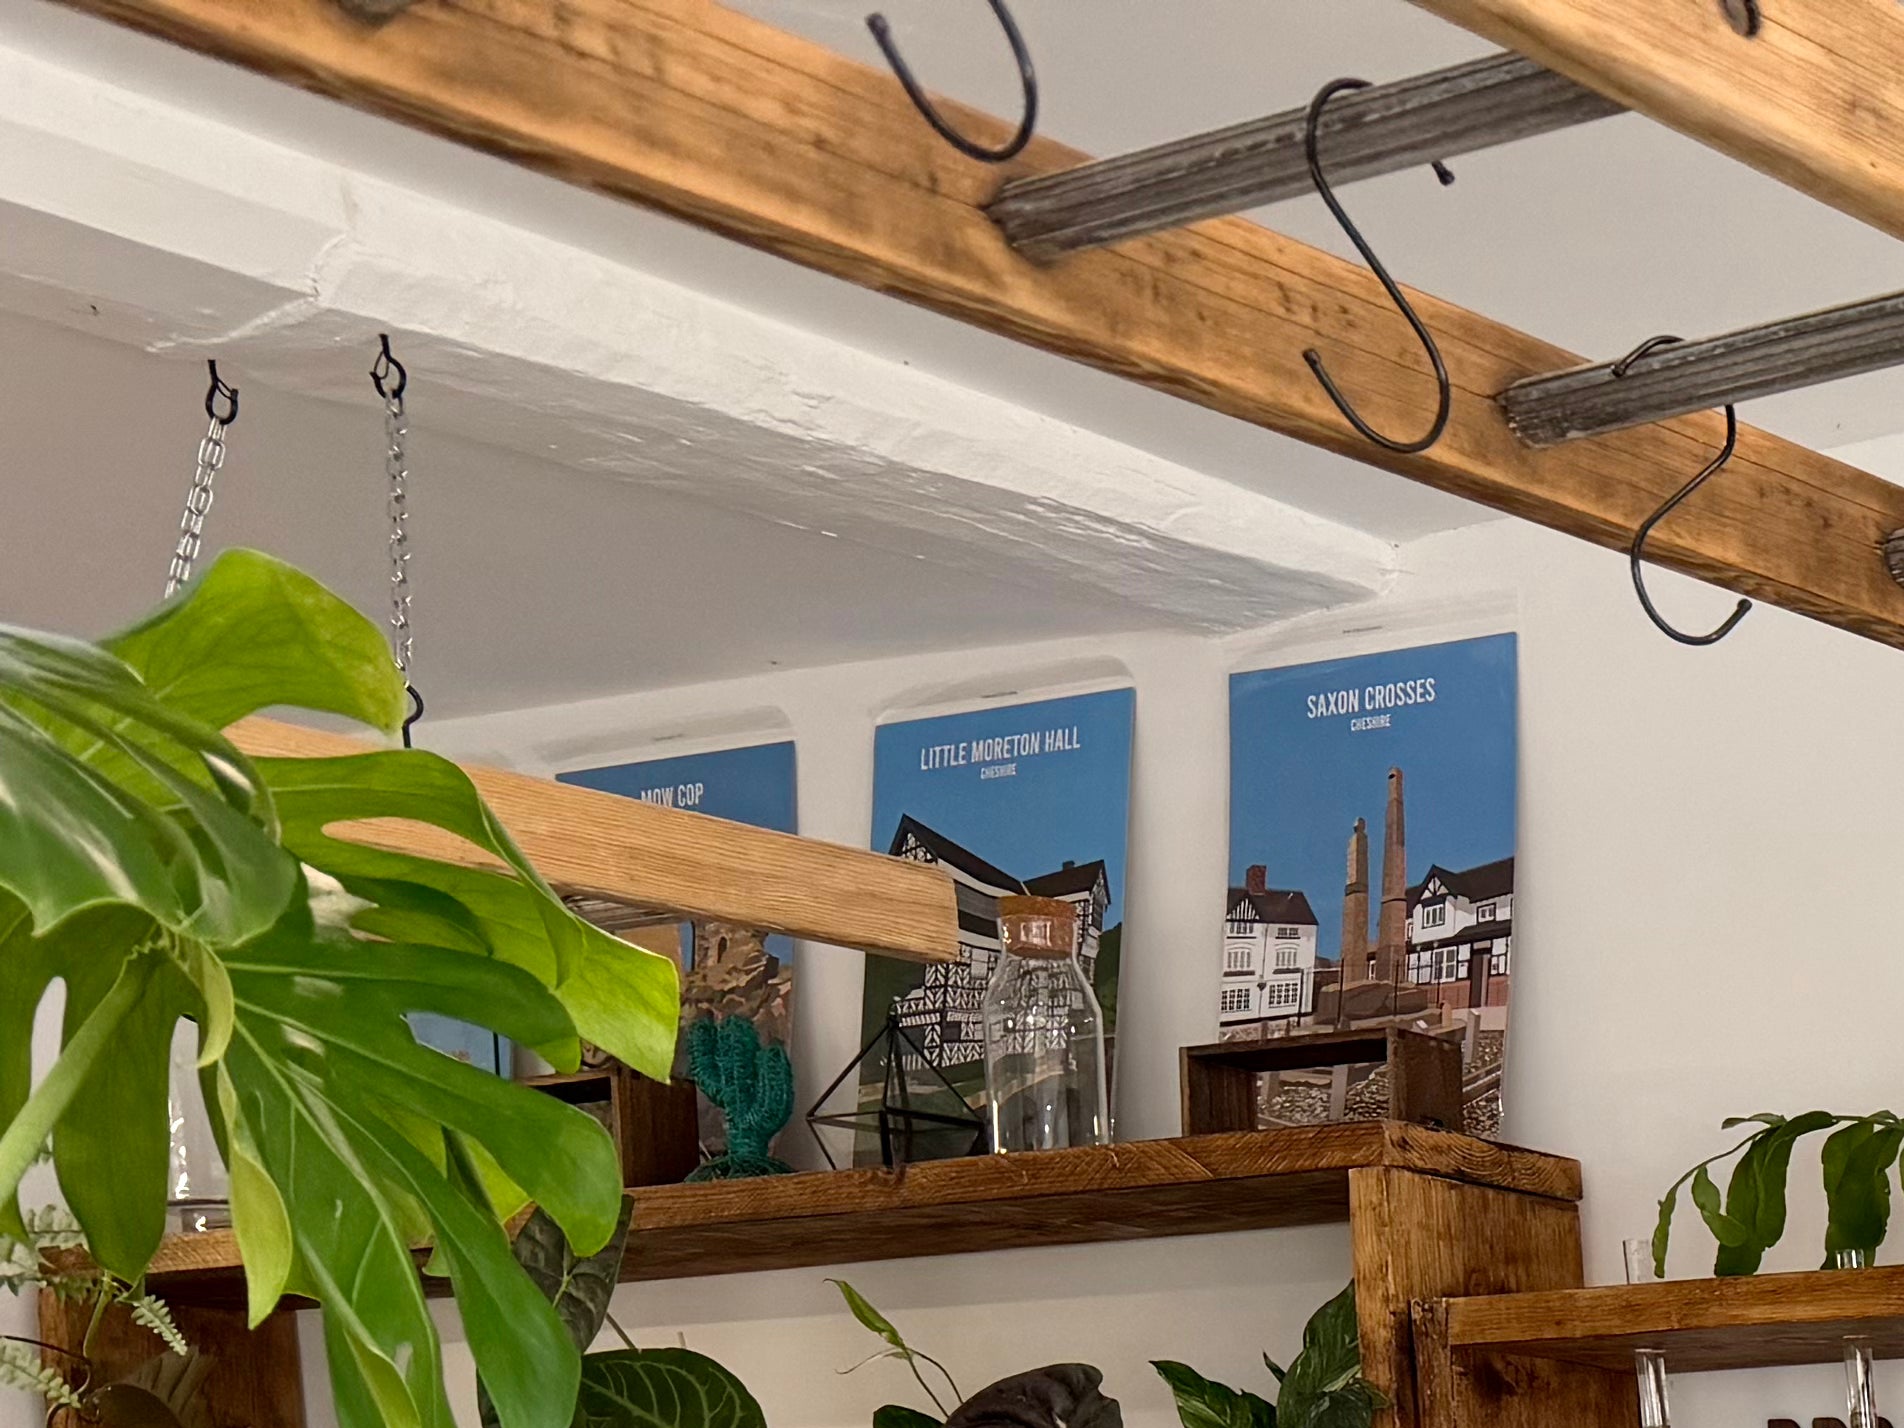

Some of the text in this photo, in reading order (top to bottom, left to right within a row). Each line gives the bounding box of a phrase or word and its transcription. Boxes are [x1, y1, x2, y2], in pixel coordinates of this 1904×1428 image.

[1307, 677, 1436, 719] SAXON CROSSES
[1351, 714, 1392, 731] CHESHIRE
[920, 725, 1081, 770] LITTLE MORETON HALL
[980, 763, 1017, 780] CHESHIRE
[677, 782, 704, 807] COP
